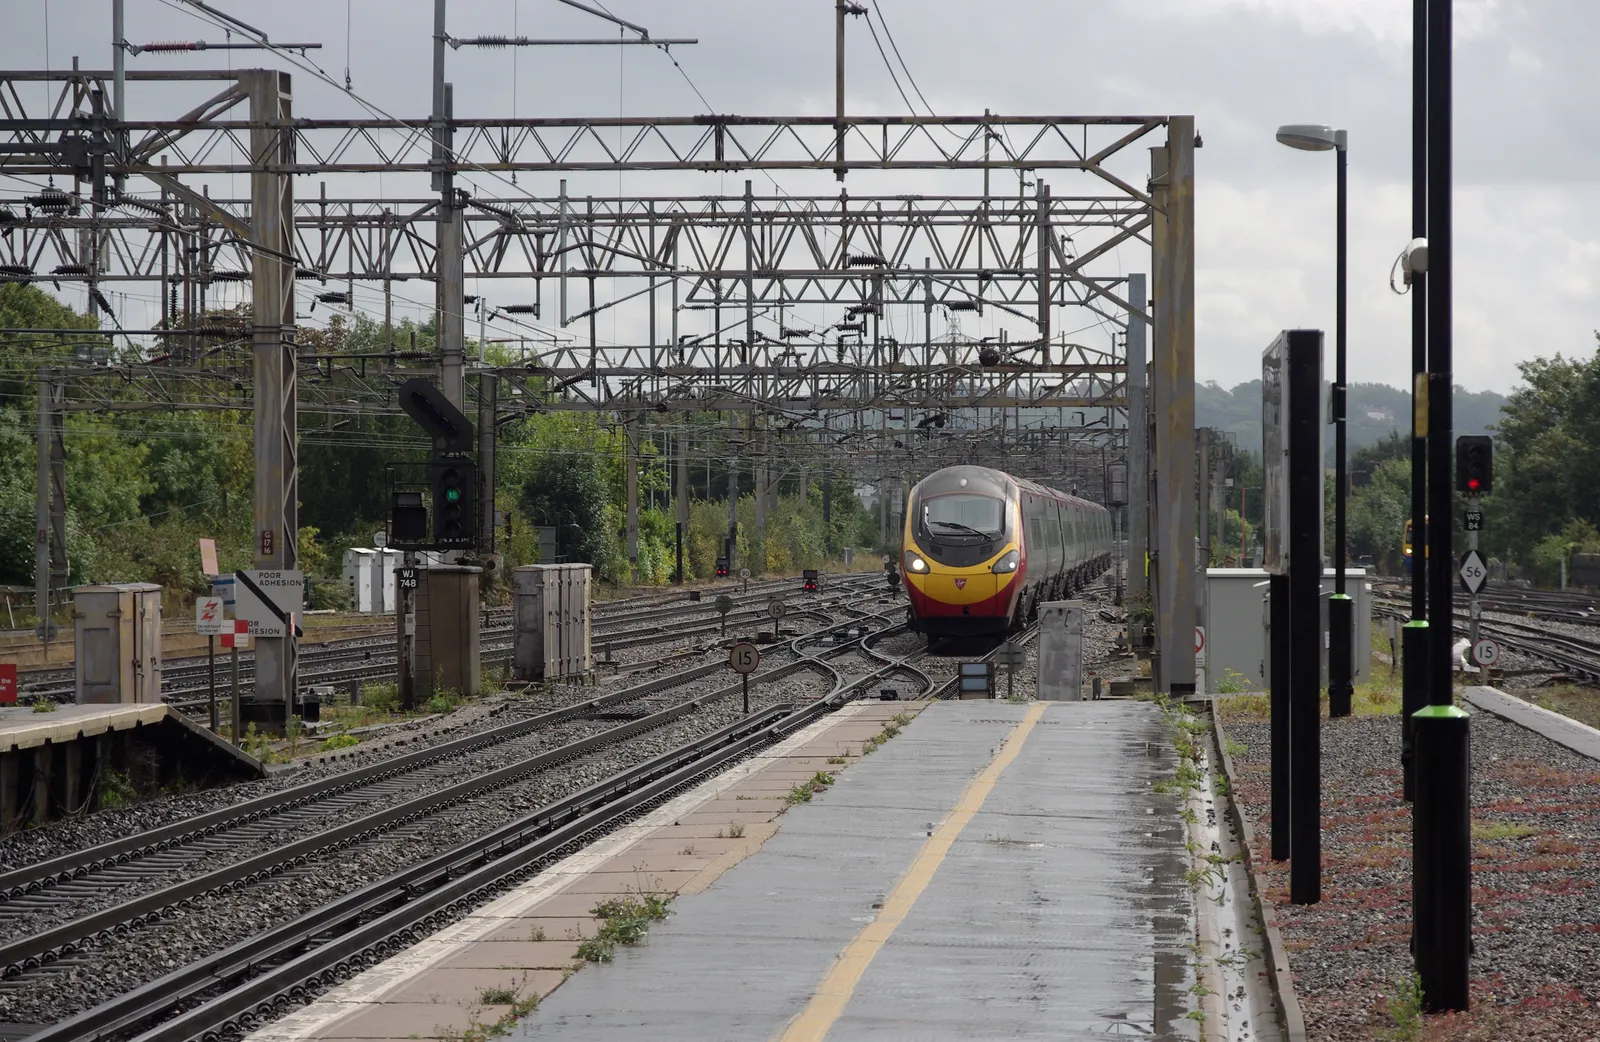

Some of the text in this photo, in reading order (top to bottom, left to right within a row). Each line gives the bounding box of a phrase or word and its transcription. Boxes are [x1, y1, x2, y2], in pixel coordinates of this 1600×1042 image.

[1466, 513, 1481, 521] WS
[1468, 522, 1479, 530] 84
[264, 531, 271, 539] G
[402, 570, 414, 578] WJ
[1466, 566, 1482, 578] 56
[259, 579, 302, 587] ADHESION
[400, 579, 417, 587] 748
[773, 605, 781, 614] 15
[1479, 646, 1493, 659] 15
[738, 651, 752, 666] 15
